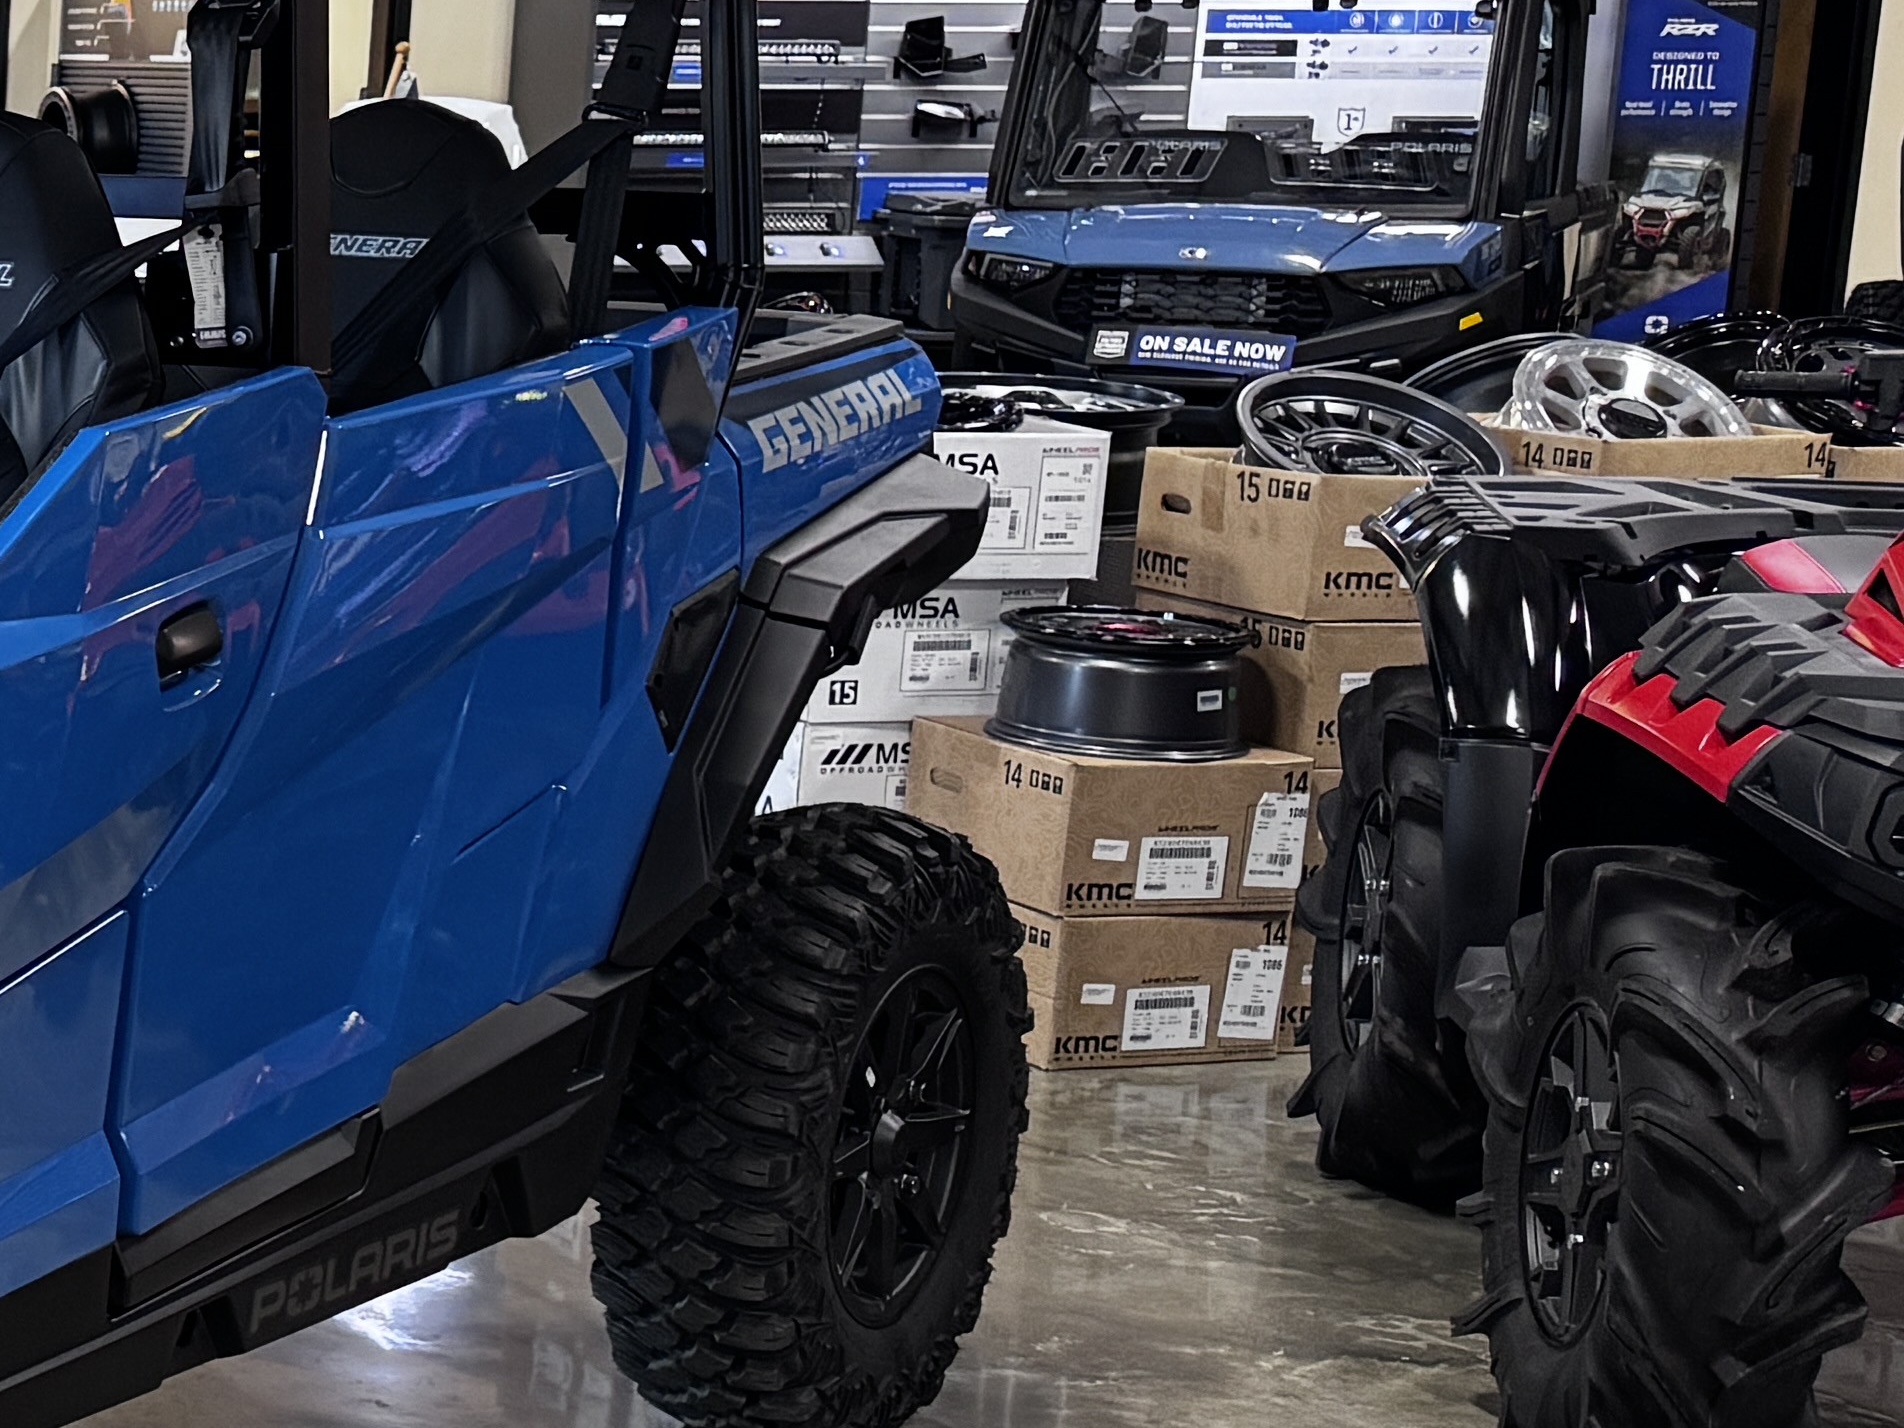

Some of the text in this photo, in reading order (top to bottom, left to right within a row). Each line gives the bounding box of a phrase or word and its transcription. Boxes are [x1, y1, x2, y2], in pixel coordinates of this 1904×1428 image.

[1650, 64, 1716, 90] THRILL
[1139, 334, 1170, 352] ON
[1173, 336, 1232, 356] SALE
[1234, 341, 1286, 362] NOW
[747, 367, 922, 474] GENERAL
[1522, 441, 1544, 470] 14
[1804, 441, 1829, 467] 14
[1237, 471, 1261, 503] 15
[893, 597, 959, 619] MSA
[831, 681, 856, 705] 15
[1003, 760, 1022, 788] 14
[1284, 772, 1309, 795] 14
[1263, 921, 1287, 946] 14
[249, 1208, 461, 1334] POLARIS
